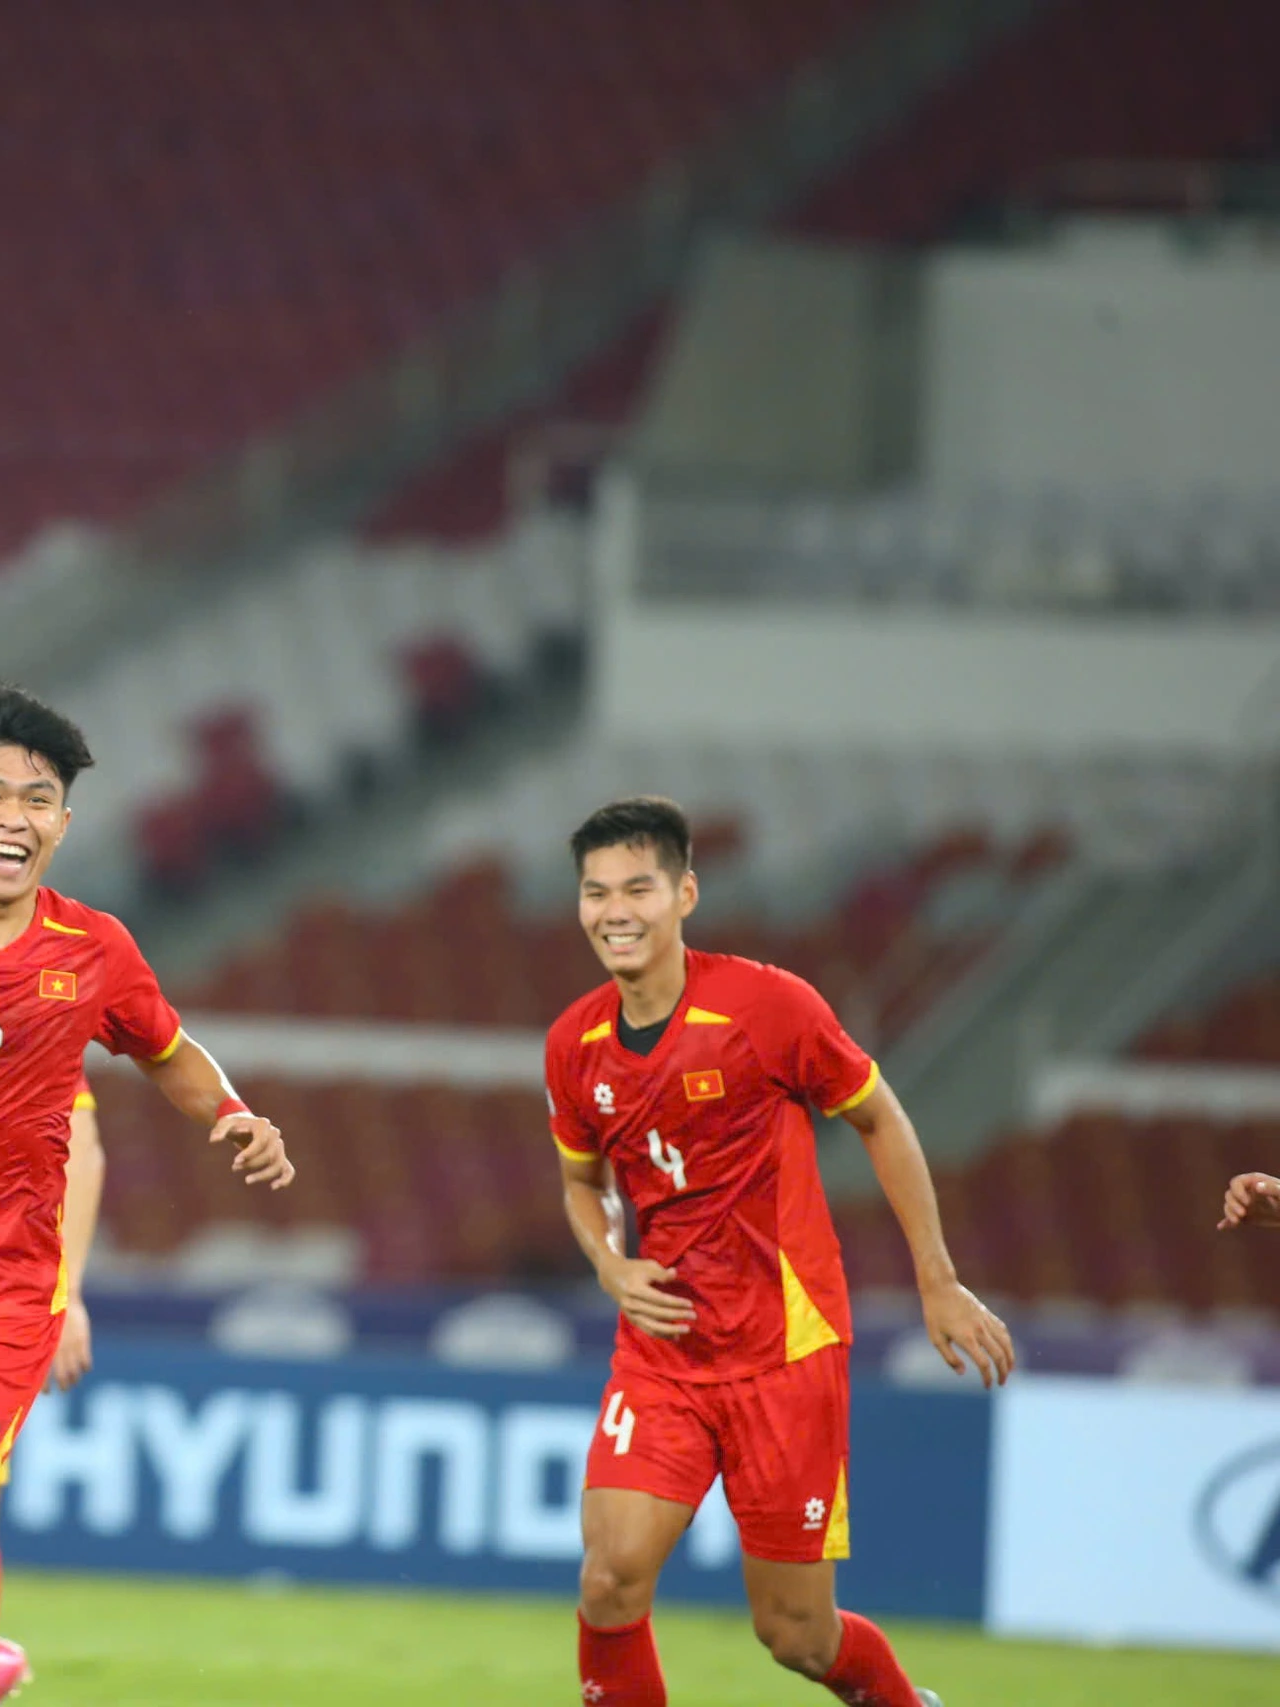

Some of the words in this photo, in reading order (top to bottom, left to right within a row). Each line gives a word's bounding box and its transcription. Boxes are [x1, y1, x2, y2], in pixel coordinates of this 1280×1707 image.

[648, 1129, 687, 1190] 4
[602, 1390, 636, 1455] 4
[8, 1383, 739, 1567] HYUND
